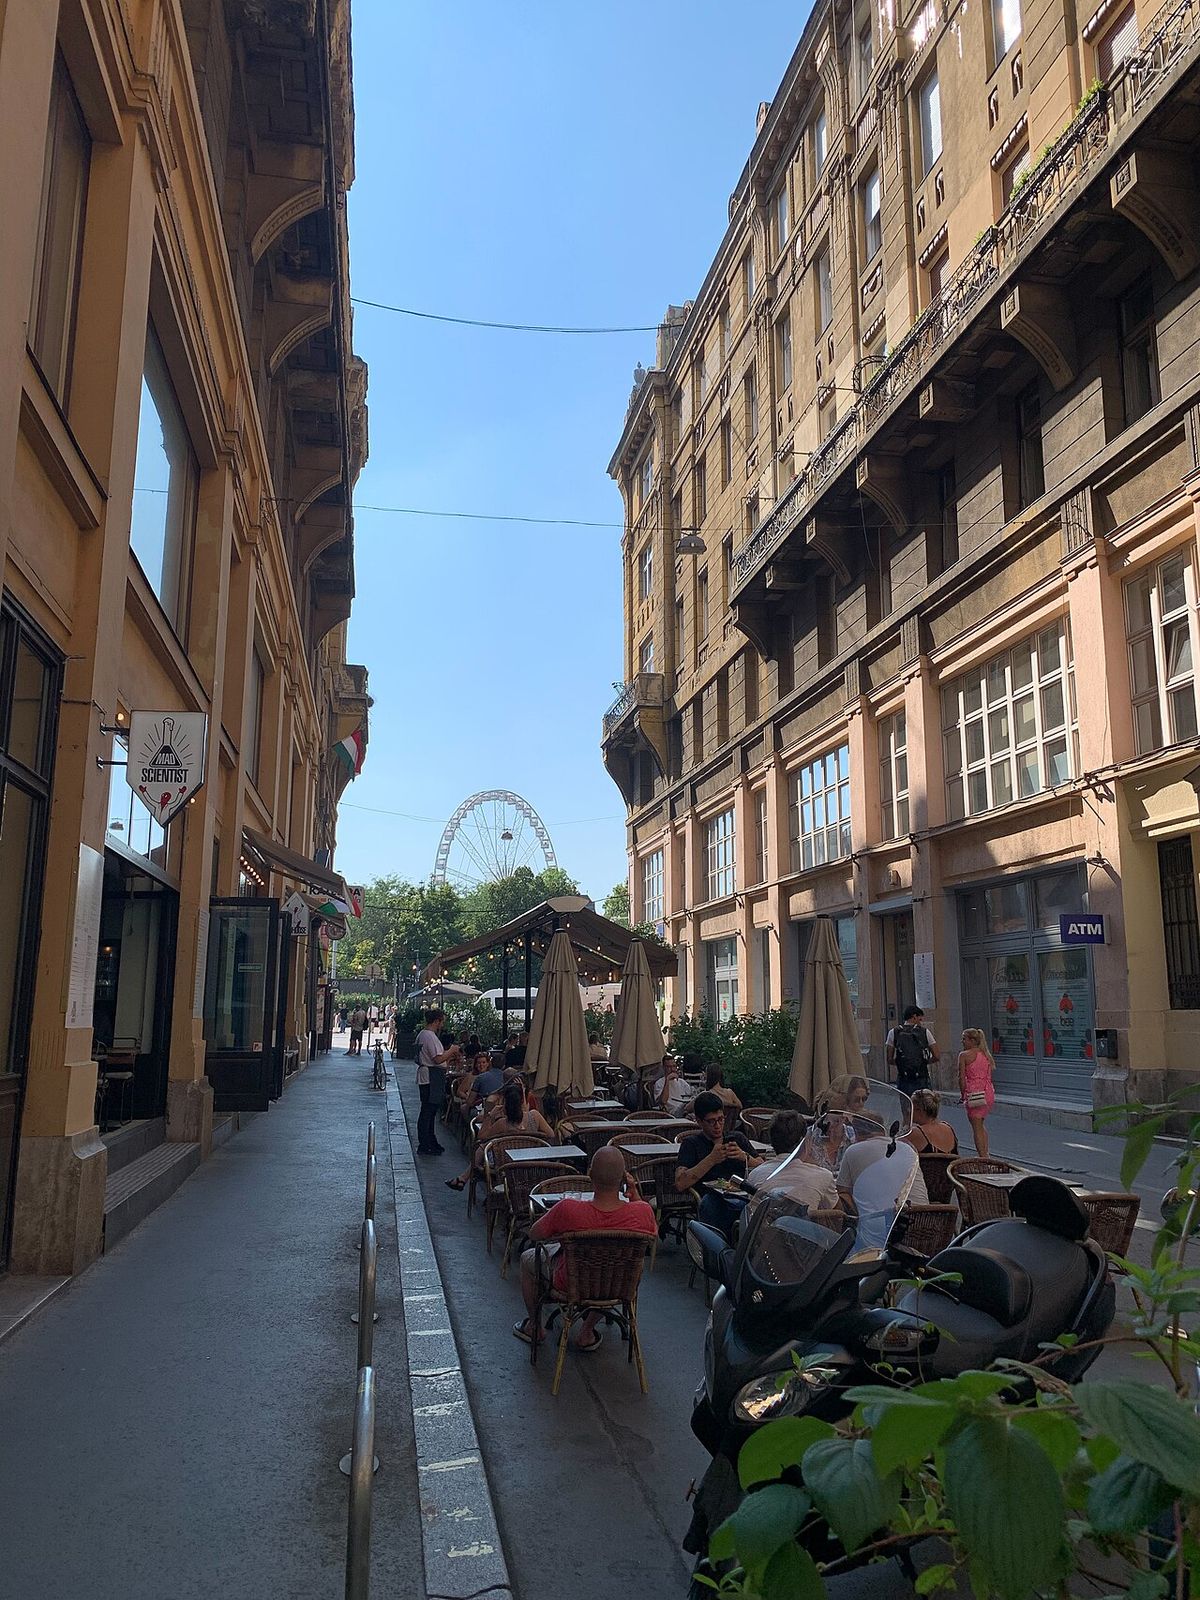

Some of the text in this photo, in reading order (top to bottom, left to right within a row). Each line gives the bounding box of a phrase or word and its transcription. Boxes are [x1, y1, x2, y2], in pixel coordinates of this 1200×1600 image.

[155, 753, 175, 765] MAD
[141, 768, 189, 783] SCIENTIST
[1068, 923, 1102, 935] ATM
